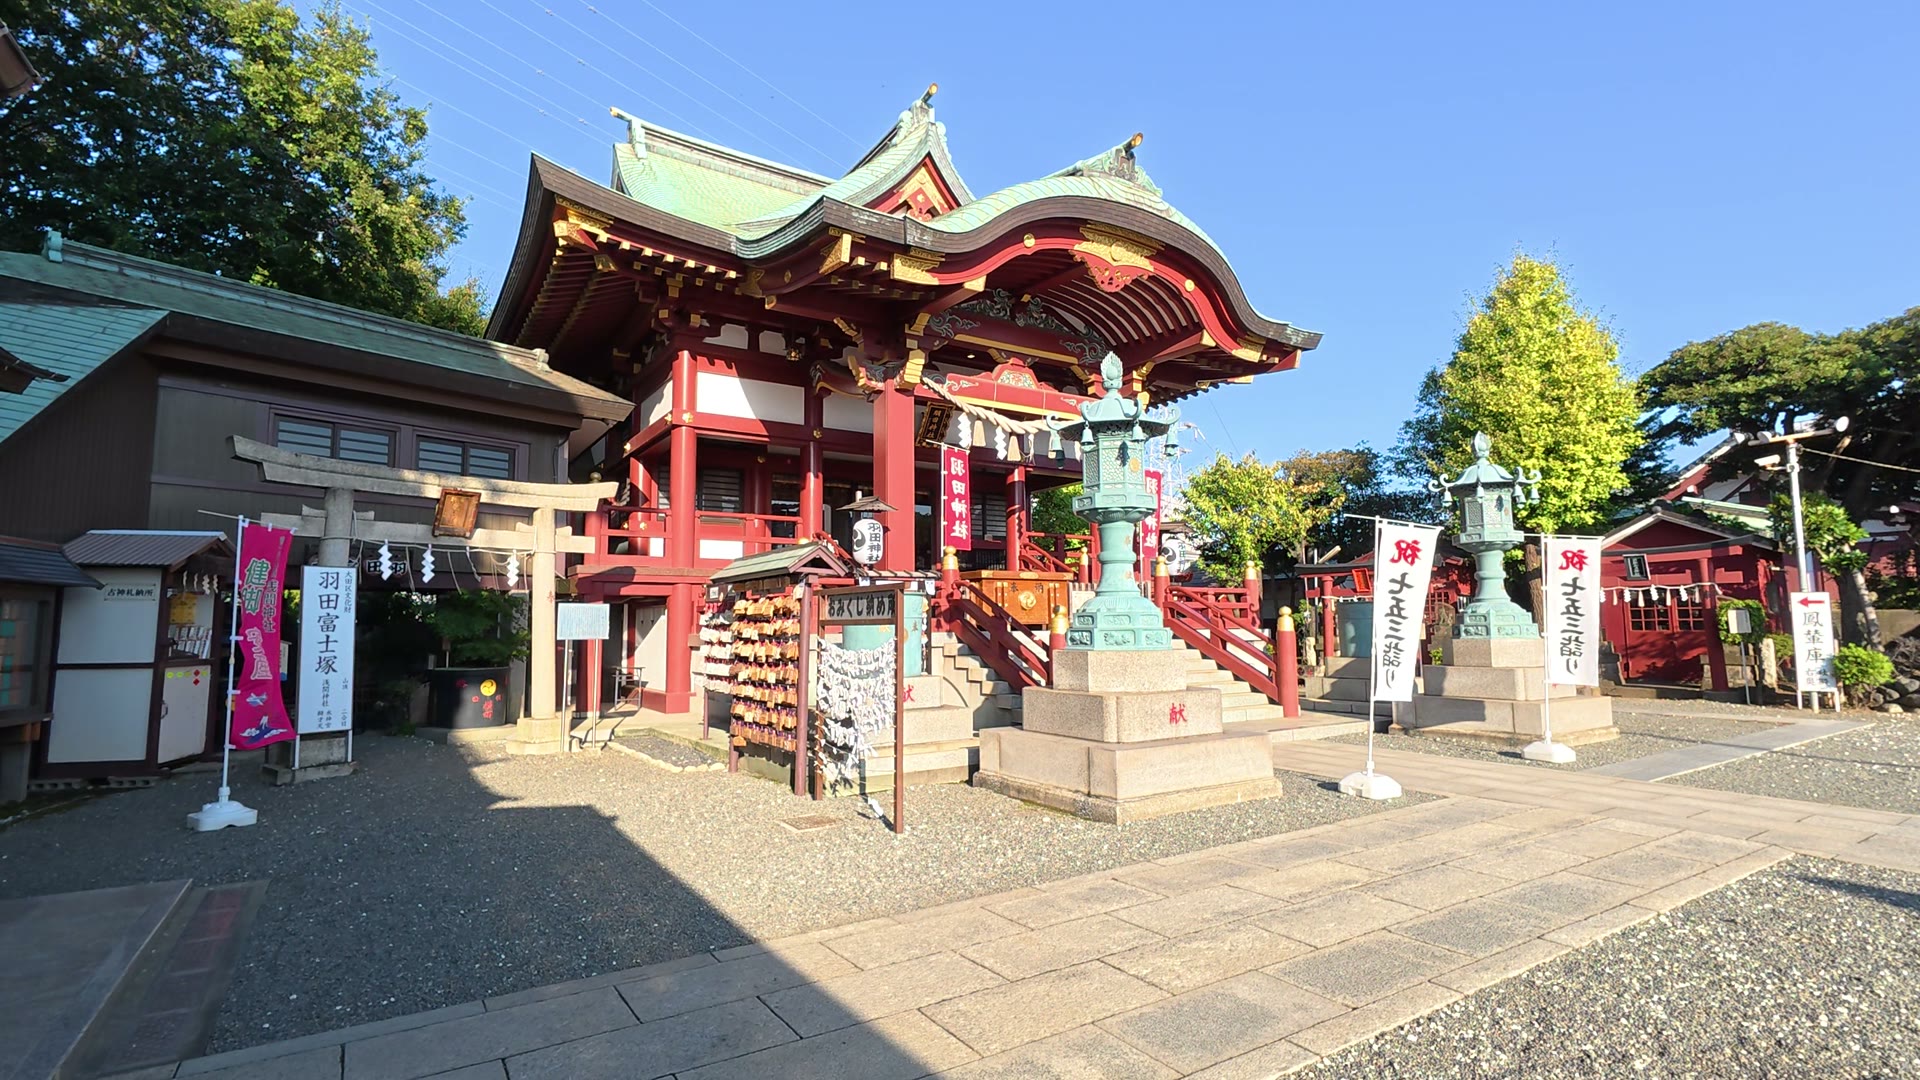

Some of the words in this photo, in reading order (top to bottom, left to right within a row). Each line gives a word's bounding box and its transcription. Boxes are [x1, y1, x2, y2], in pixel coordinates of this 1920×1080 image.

[866, 522, 881, 562] 羽田神社
[344, 571, 353, 613] 大田区文化財
[315, 571, 340, 675] 羽田富士塚
[1168, 702, 1188, 725] 献
